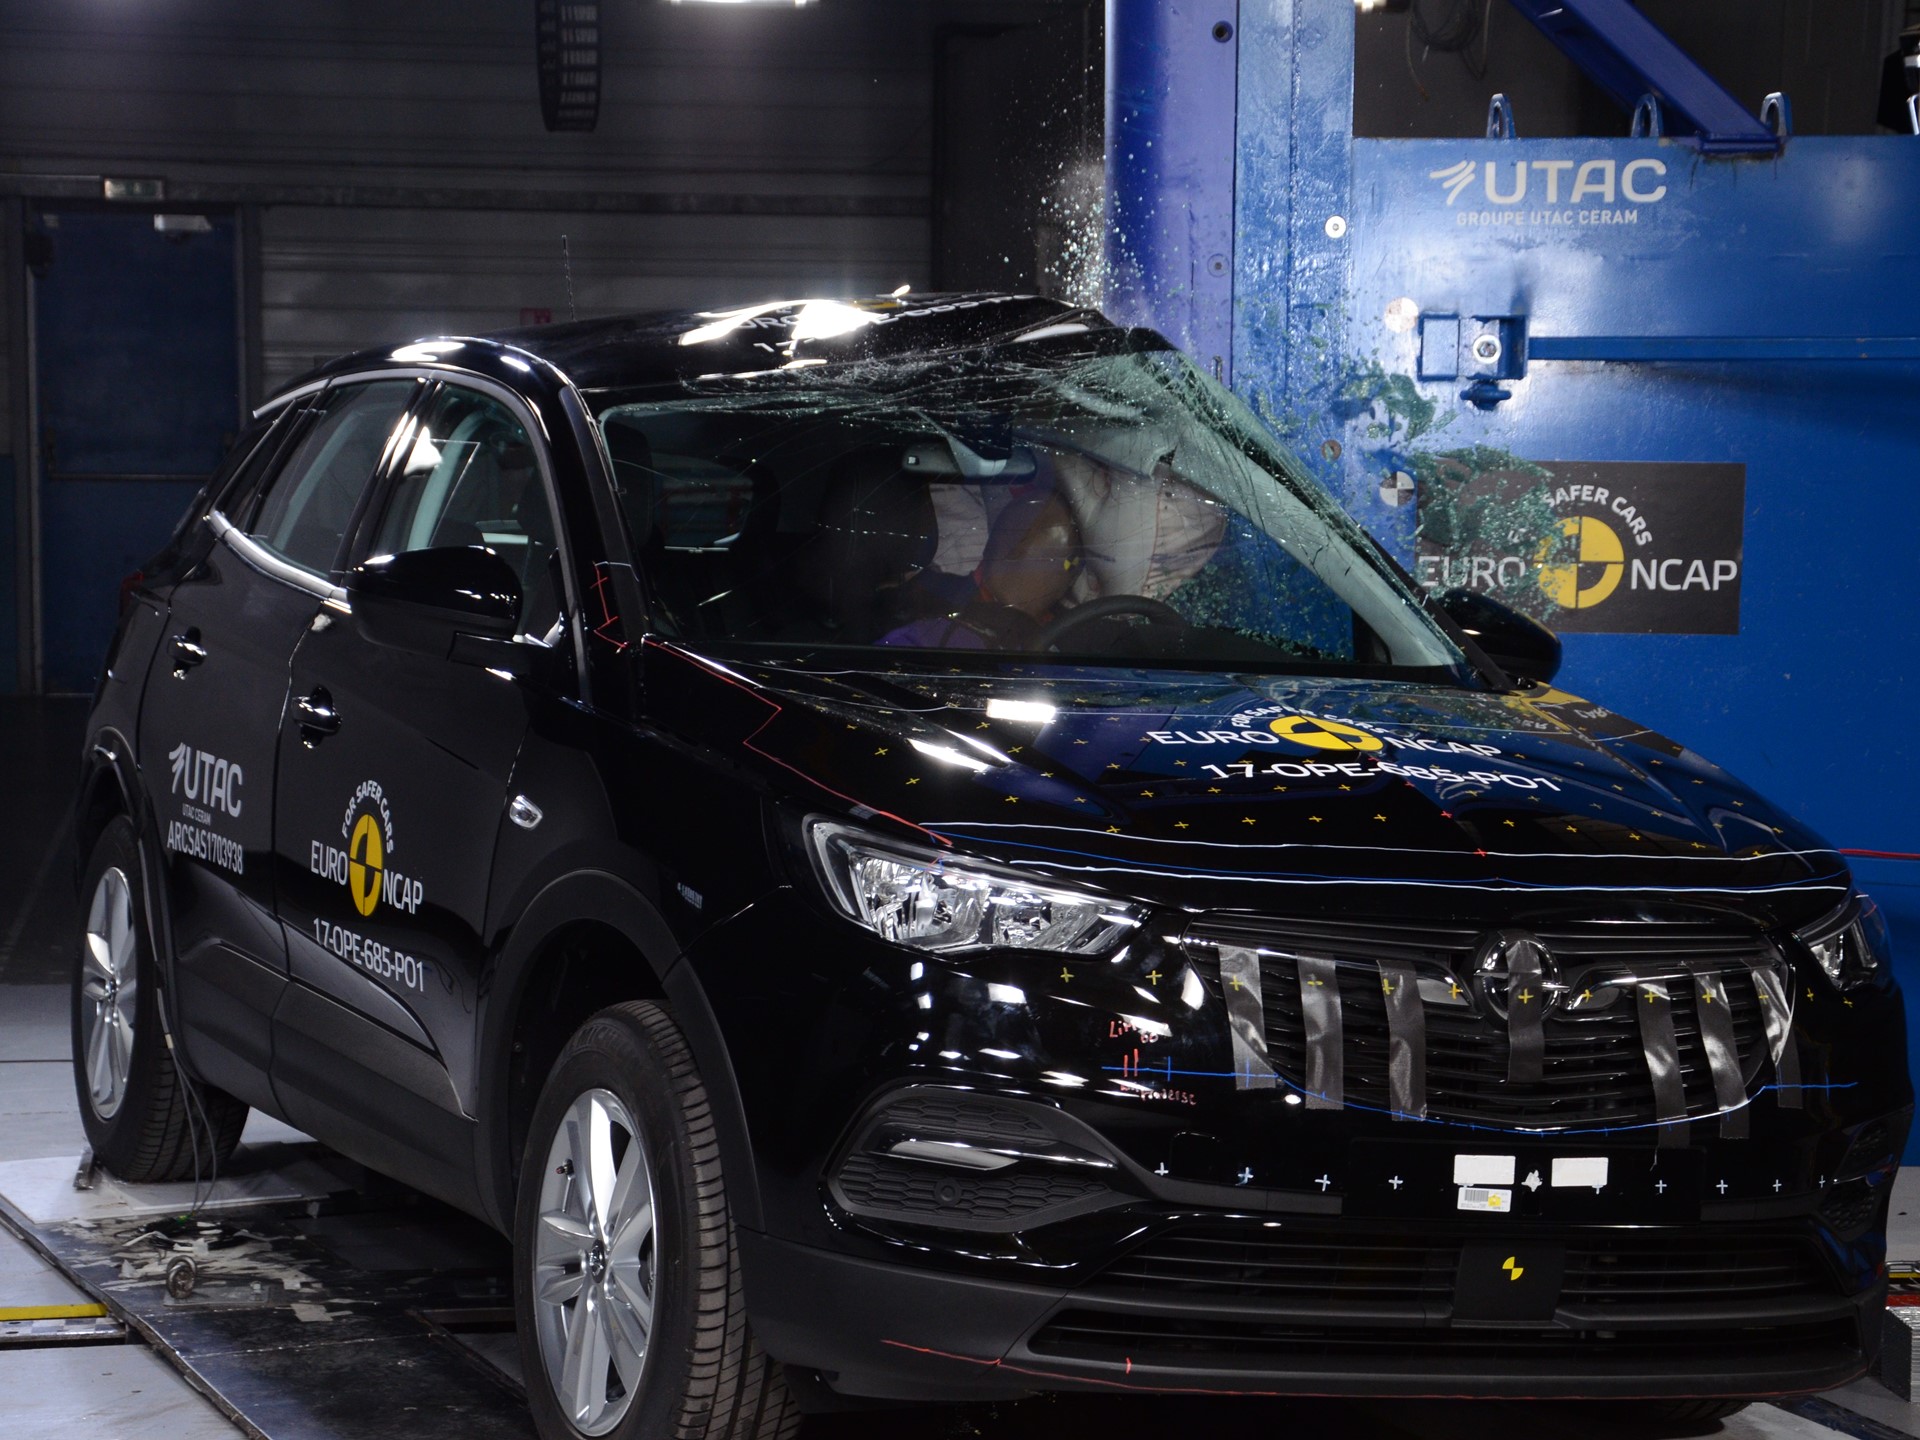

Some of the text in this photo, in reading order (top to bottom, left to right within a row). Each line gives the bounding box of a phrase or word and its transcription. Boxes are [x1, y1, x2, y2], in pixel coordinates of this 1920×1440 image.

[1485, 158, 1667, 204] UTAC
[1456, 209, 1638, 226] GROUPE UTAC CERAM
[1611, 496, 1652, 546] CARS
[1418, 556, 1738, 592] EURO NCAP
[1146, 730, 1502, 757] EURO NCAP
[1323, 714, 1389, 734] CARS
[184, 746, 243, 818] UTAC
[342, 780, 394, 854] FOR SAFER CARS
[311, 839, 423, 915] EURO NCAP
